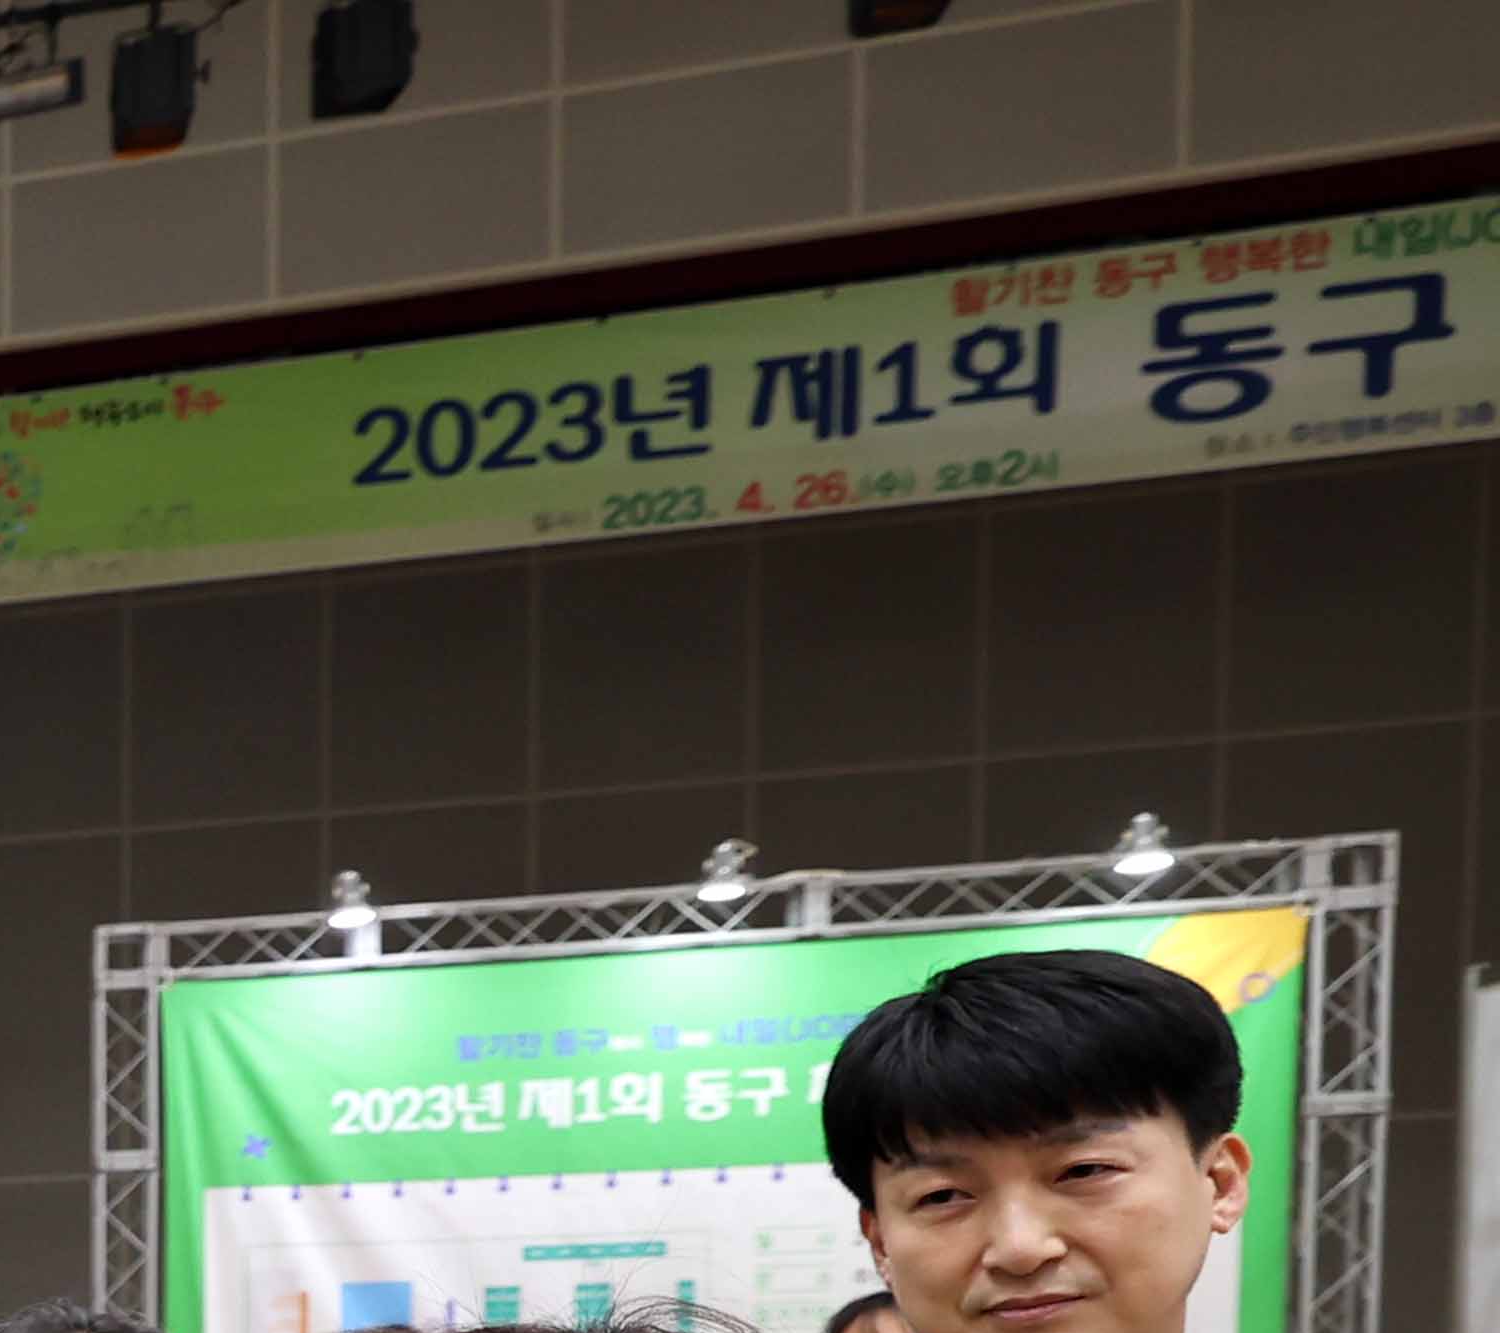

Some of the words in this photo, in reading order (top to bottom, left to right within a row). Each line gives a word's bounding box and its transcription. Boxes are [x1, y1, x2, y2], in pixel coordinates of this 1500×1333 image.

[951, 266, 1077, 316] 활기찬
[1094, 252, 1177, 297] 동구
[1201, 231, 1330, 282] 행복한
[352, 362, 712, 486] 2023년
[748, 320, 1061, 442] 제1회
[1140, 273, 1455, 424] 동구
[329, 1082, 506, 1136] 2023년
[517, 1073, 663, 1128] 제1회
[684, 1067, 790, 1121] 동구
